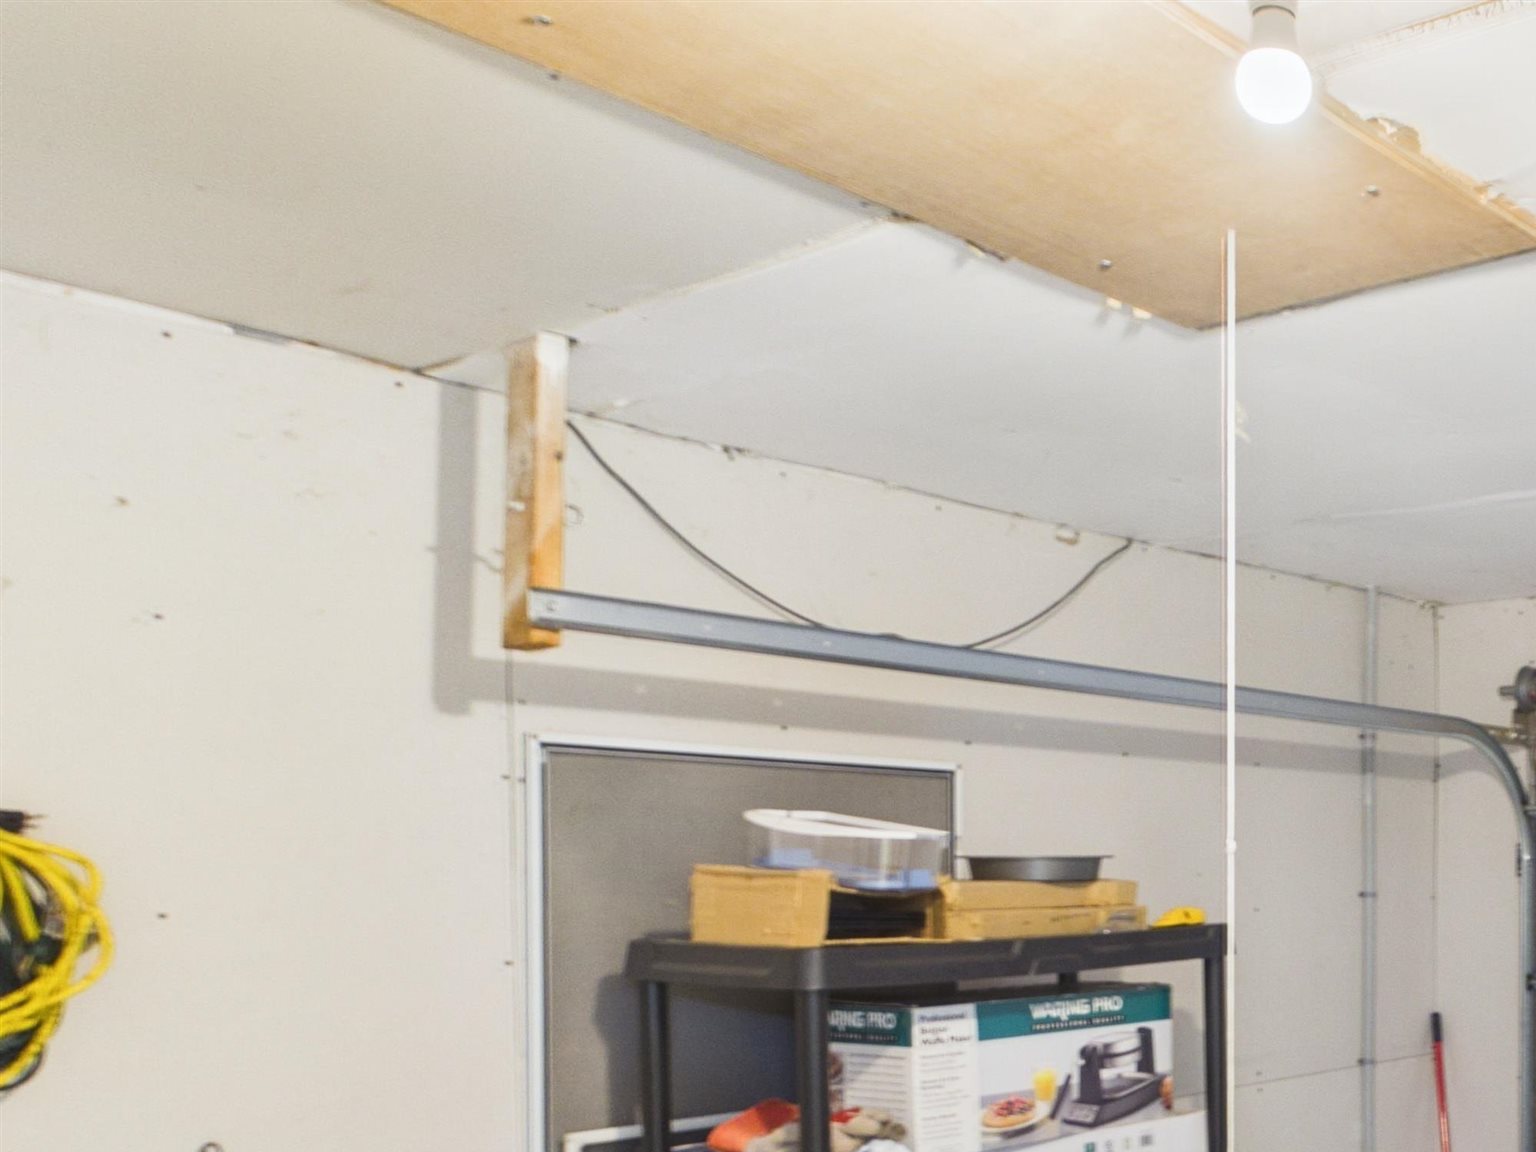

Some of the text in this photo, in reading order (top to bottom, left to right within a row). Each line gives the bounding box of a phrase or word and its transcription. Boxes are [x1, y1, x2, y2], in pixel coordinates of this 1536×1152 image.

[1028, 995, 1124, 1021] WARING PRO
[868, 1011, 897, 1029] PRO
